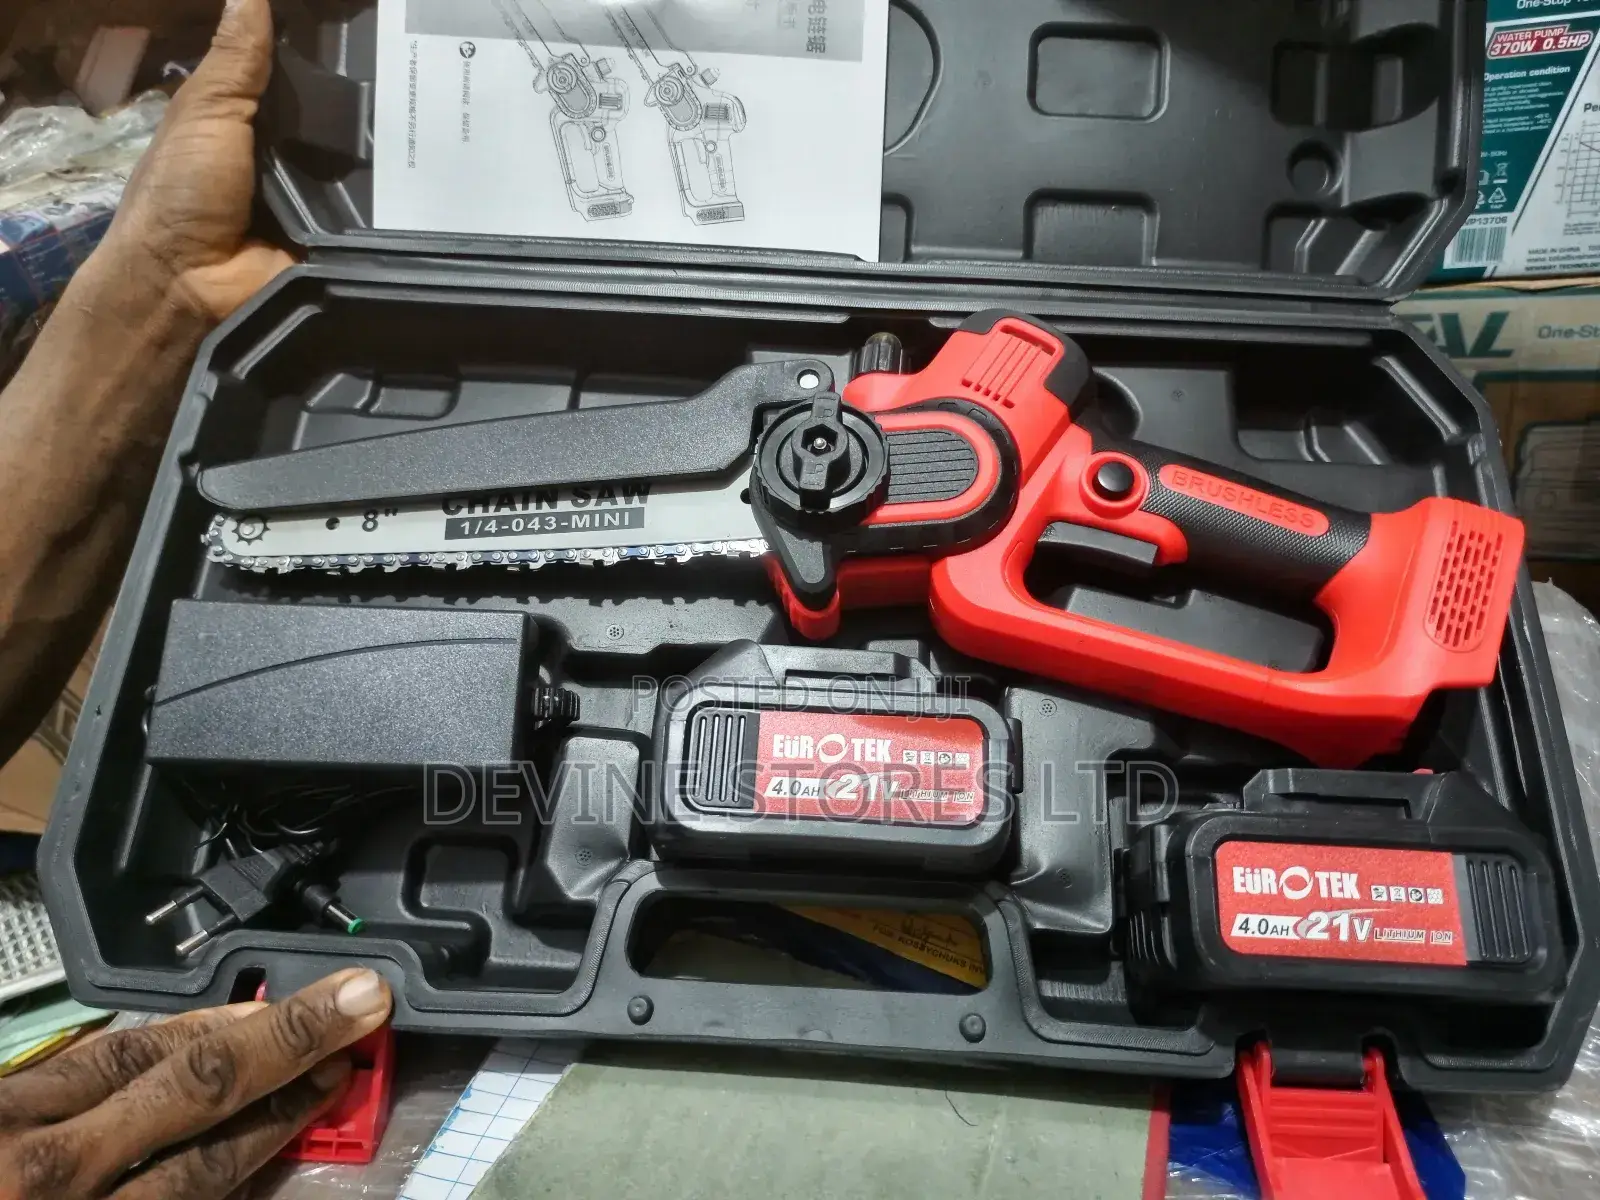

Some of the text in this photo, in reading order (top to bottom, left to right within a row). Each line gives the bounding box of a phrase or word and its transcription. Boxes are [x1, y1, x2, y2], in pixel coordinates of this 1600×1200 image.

[1490, 34, 1590, 56] 370W 0.5HP
[1497, 28, 1564, 42] WATER PUMP
[1529, 65, 1571, 76] condition
[441, 482, 650, 516] CHAIN SAW
[1171, 470, 1315, 528] BRUSHLESS
[460, 511, 630, 536] 1/4-043-MINI
[1375, 928, 1424, 941] LITHIUM
[1431, 931, 1452, 942] ION
